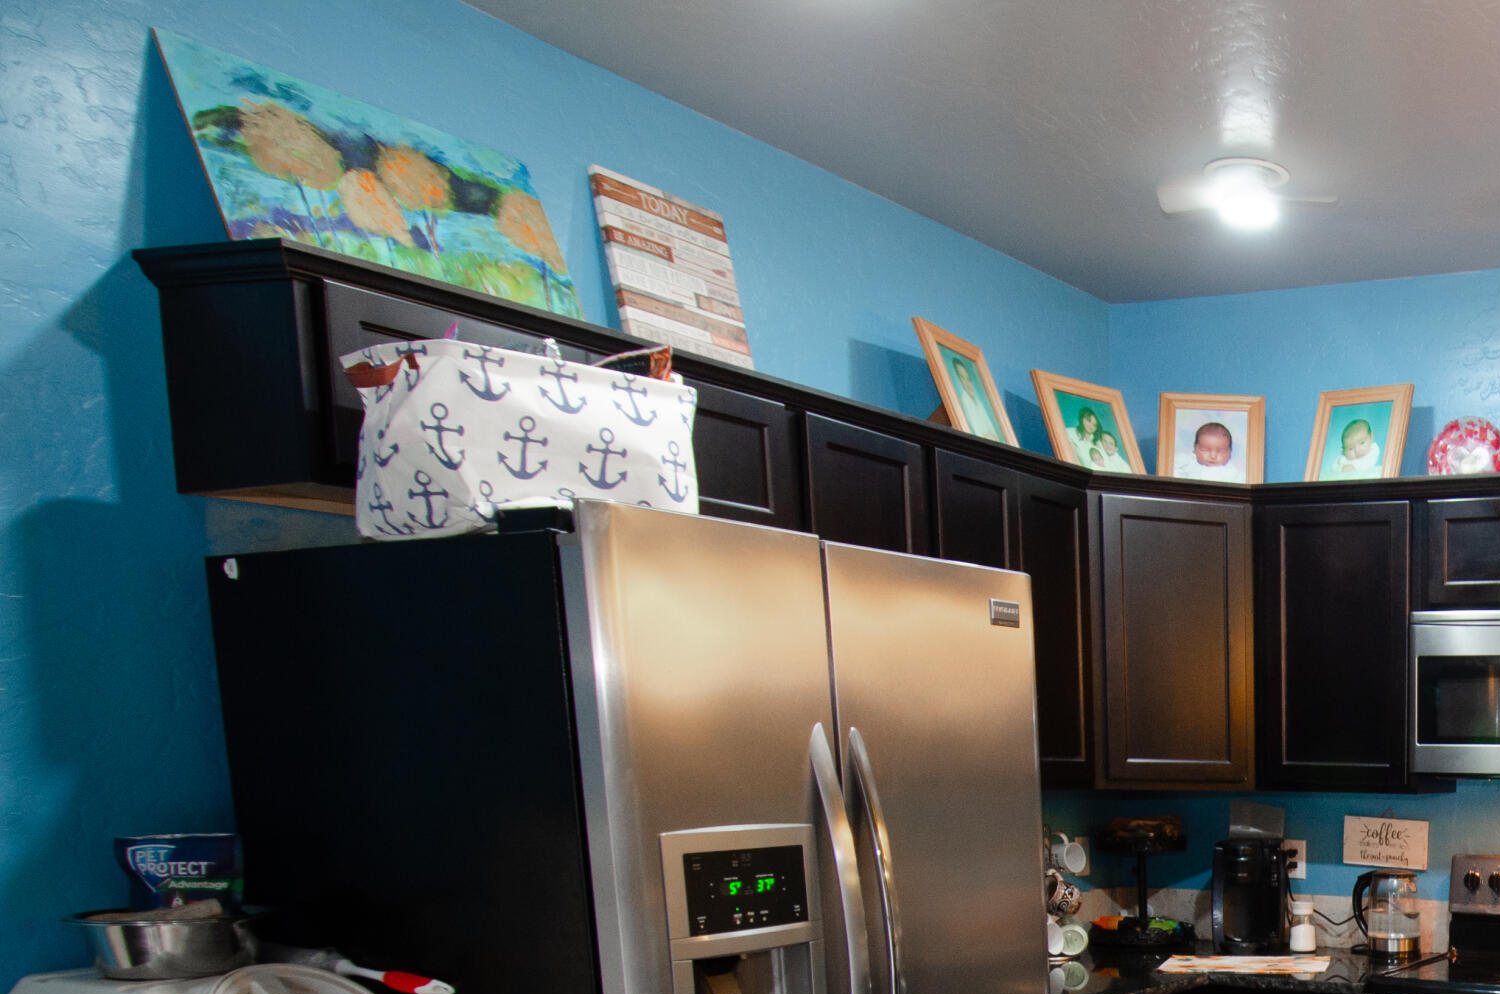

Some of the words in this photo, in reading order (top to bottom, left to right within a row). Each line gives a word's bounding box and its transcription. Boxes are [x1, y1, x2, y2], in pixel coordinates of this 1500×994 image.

[637, 191, 690, 226] TODAY
[627, 235, 670, 257] AMAZING
[1366, 823, 1402, 846] coffee
[135, 849, 168, 862] PET
[137, 861, 208, 877] PROTECT
[168, 880, 228, 890] Advantage
